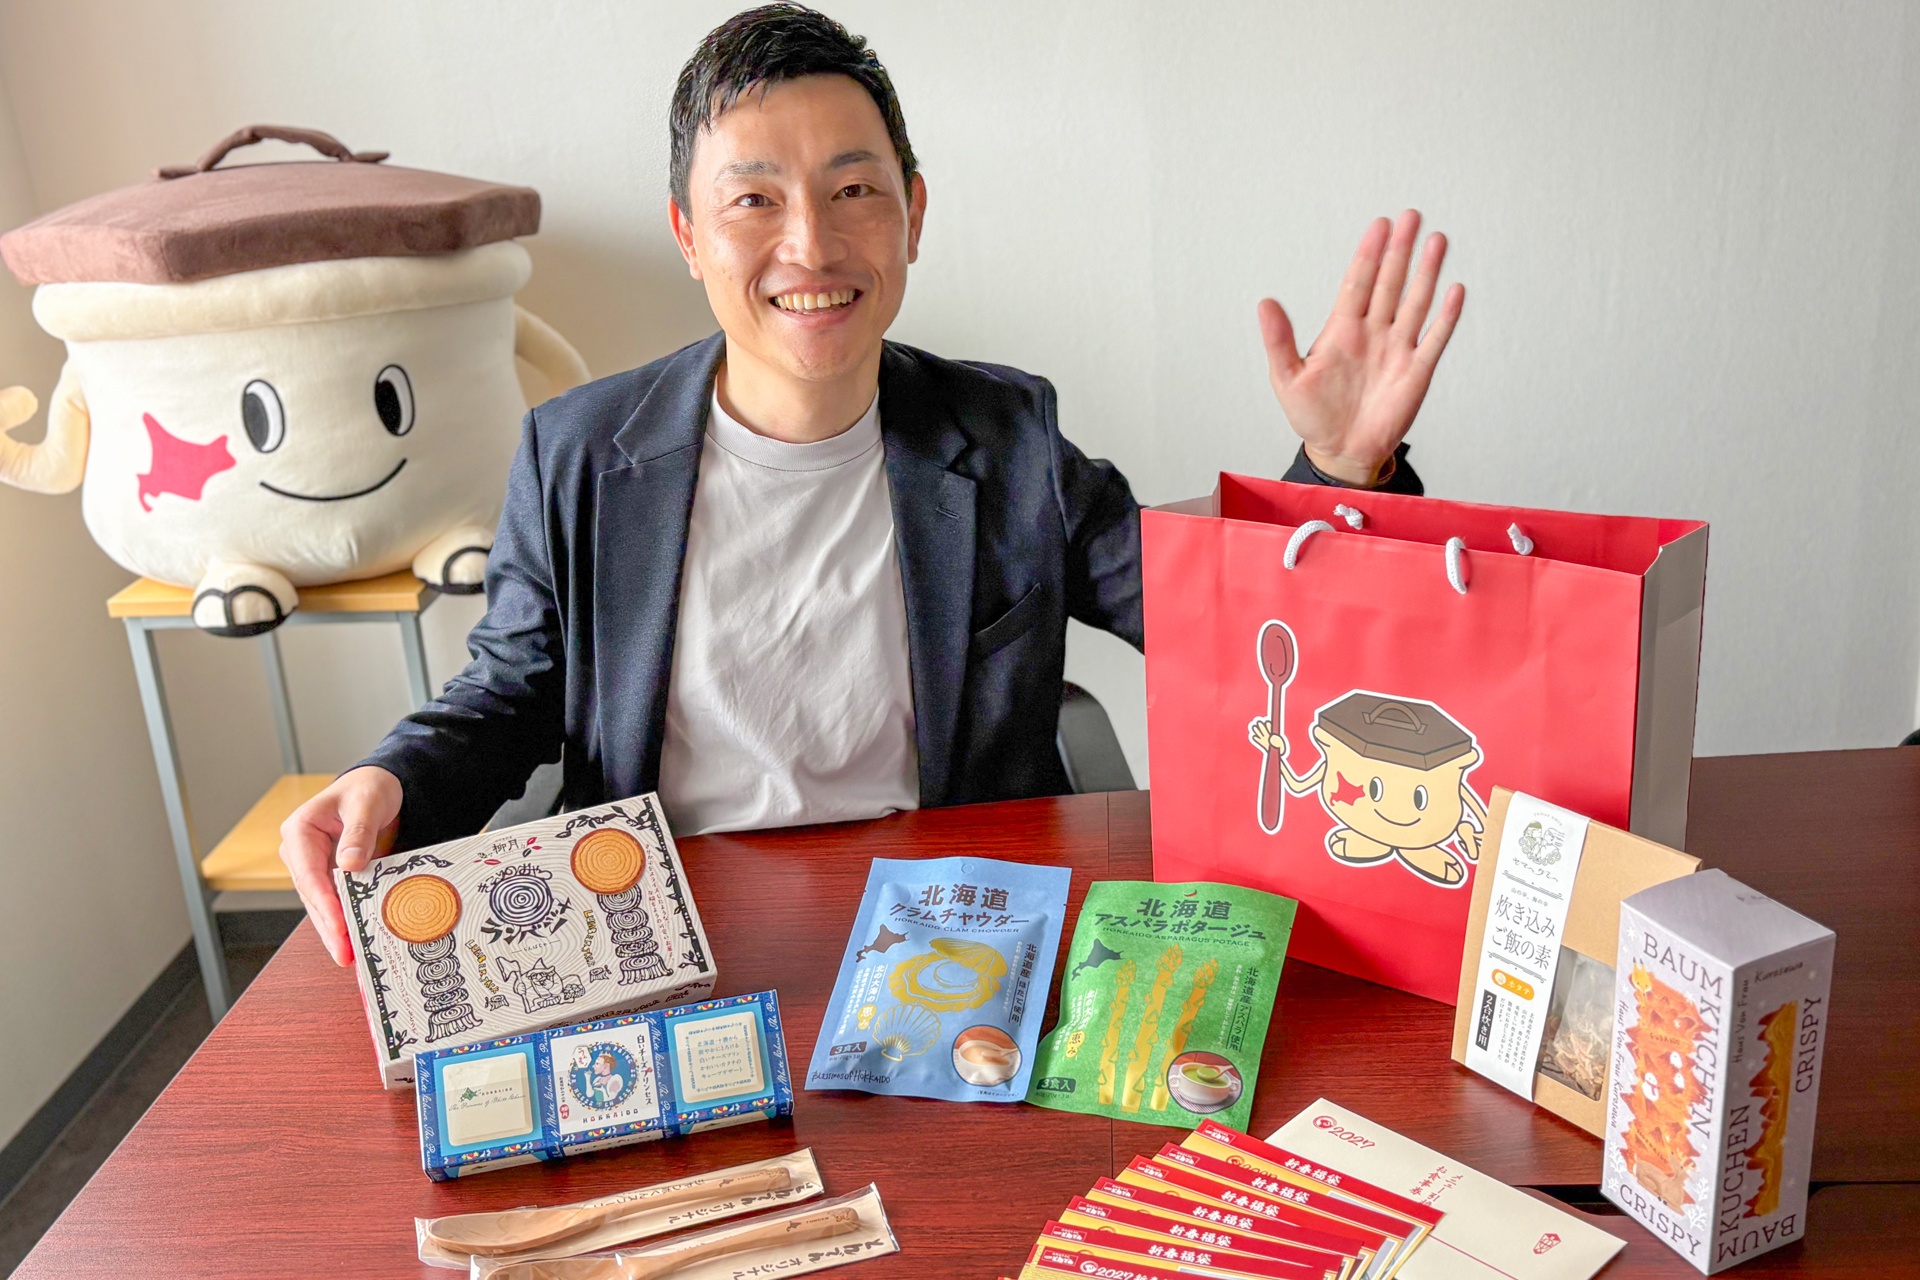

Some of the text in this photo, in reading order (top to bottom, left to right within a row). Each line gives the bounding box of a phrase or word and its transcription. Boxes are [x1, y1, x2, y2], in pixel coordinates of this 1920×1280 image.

[918, 883, 1009, 911] 北海道
[1136, 898, 1232, 920] 北海道
[889, 902, 1029, 928] クラムチャウダー
[895, 917, 940, 930] HOKKAIDO
[1094, 913, 1267, 940] アスパラポタージュ
[1494, 894, 1556, 938] 炊き込み
[1102, 927, 1250, 947] HOKKAIDO ASPARAGUS POTAGE
[1492, 926, 1552, 970] ご飯の素
[1643, 932, 1723, 1000] BAUM
[1507, 980, 1530, 996] ホタテ
[1478, 995, 1493, 1047] 2合炊き用
[834, 1044, 863, 1056] 3食入
[1795, 997, 1821, 1093] CRISPY
[636, 1034, 652, 1105] 白いチーズプリンセス
[1610, 999, 1630, 1129] Haus Von Frau Kurosawa
[1690, 996, 1721, 1139] KUCHEN
[1042, 1078, 1071, 1091] 3食入
[582, 1108, 639, 1124] HOKKAIDO
[1328, 1126, 1375, 1149] 2027
[1285, 1158, 1342, 1186] 新春福袋
[1409, 1166, 1447, 1196] お食事券
[1720, 1105, 1751, 1236] KUCHEN
[1251, 1177, 1310, 1204] 新春福袋
[669, 1202, 735, 1224] オリジナル
[1221, 1191, 1280, 1217] 新春福袋
[1192, 1206, 1253, 1230] 新春福袋
[1620, 1184, 1701, 1256] CRISPY
[1169, 1225, 1232, 1247] 新春福袋
[1717, 1214, 1797, 1263] BAUM
[1148, 1245, 1212, 1265] 新春福袋
[733, 1258, 802, 1280] オリジナル
[1095, 1268, 1134, 1280] 2027
